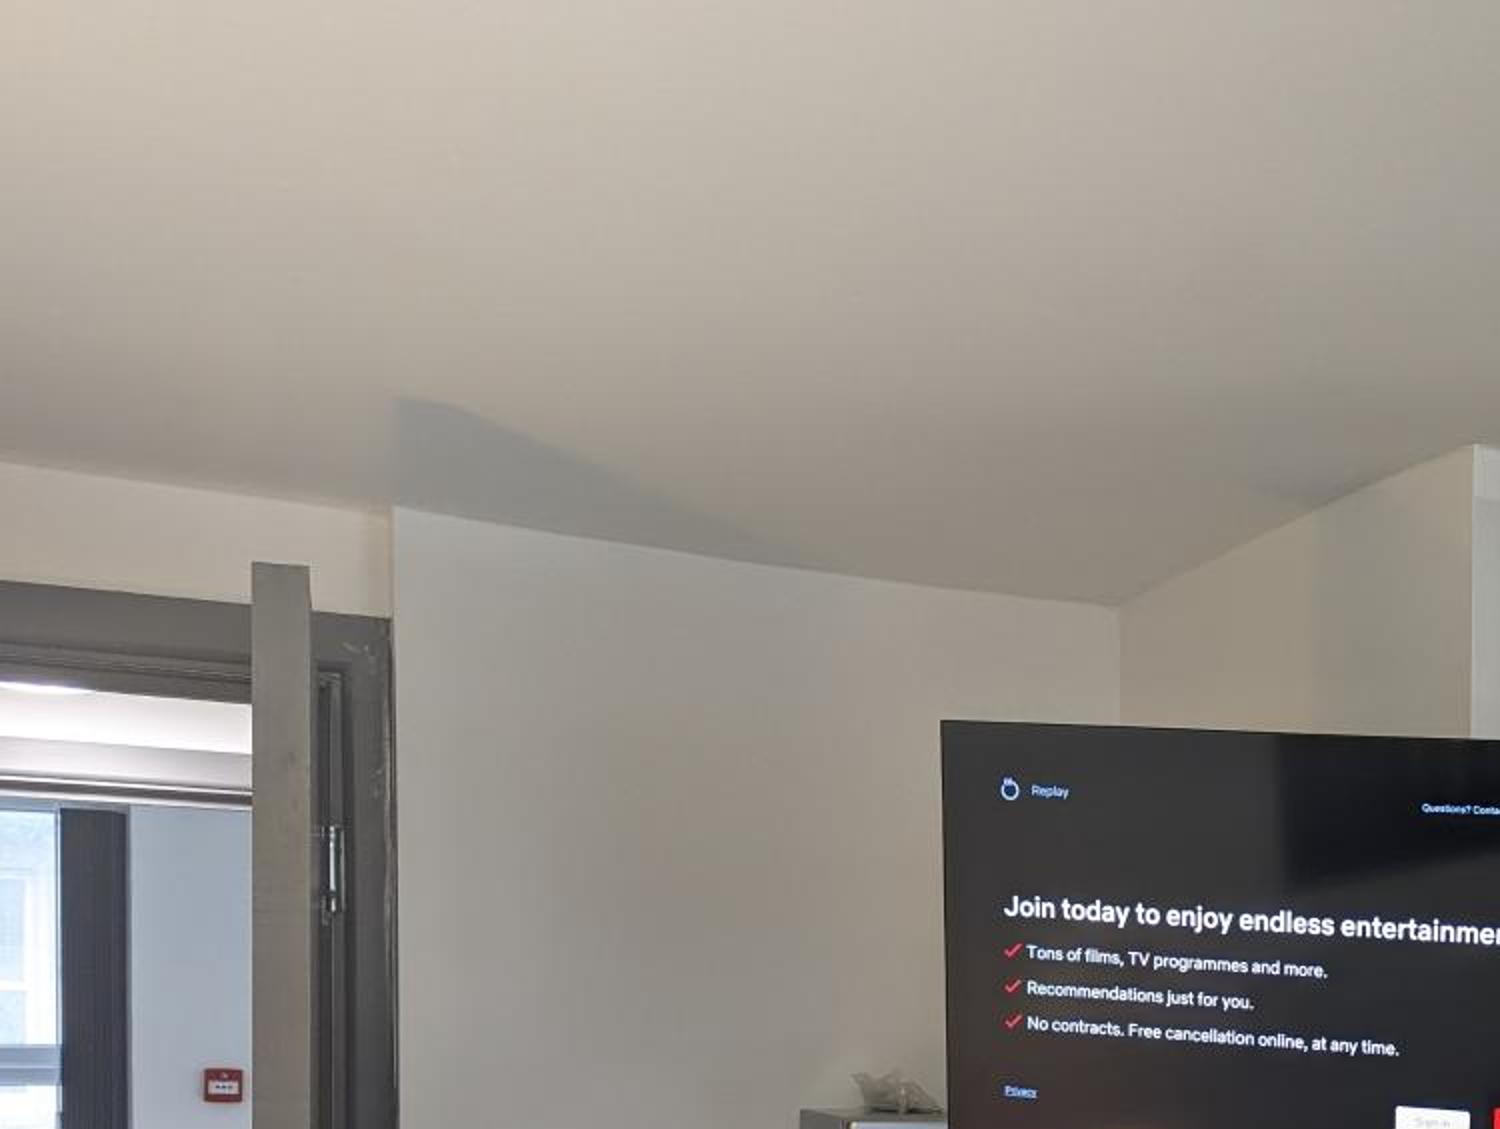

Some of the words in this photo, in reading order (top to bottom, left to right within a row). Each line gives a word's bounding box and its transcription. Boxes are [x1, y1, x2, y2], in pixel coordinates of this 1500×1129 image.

[1031, 784, 1069, 800] Replay
[1421, 803, 1471, 815] Questions?
[1004, 895, 1055, 919] Join
[1061, 898, 1130, 928] today
[1135, 902, 1160, 924] to
[1166, 905, 1233, 934] enjoy
[1239, 909, 1335, 935] endless
[1026, 944, 1063, 960] Tons
[1067, 947, 1083, 962] of
[1084, 948, 1124, 968] films,
[1128, 951, 1150, 966] TV
[1153, 955, 1249, 973] programmes
[1252, 960, 1281, 976] and
[1284, 965, 1328, 979] more.
[1027, 979, 1164, 1004] Recommendations
[1165, 988, 1194, 1007] just
[1197, 993, 1218, 1008] for
[1221, 996, 1255, 1011] you.
[1027, 1016, 1049, 1031] No
[1051, 1018, 1125, 1038] contracts.
[1128, 1023, 1161, 1039] Free
[1165, 1026, 1255, 1047] cancellation
[1258, 1033, 1308, 1052] online,
[1311, 1036, 1327, 1051] at
[1330, 1041, 1358, 1057] any
[1361, 1040, 1400, 1057] time.
[1004, 1085, 1038, 1099] Privacy
